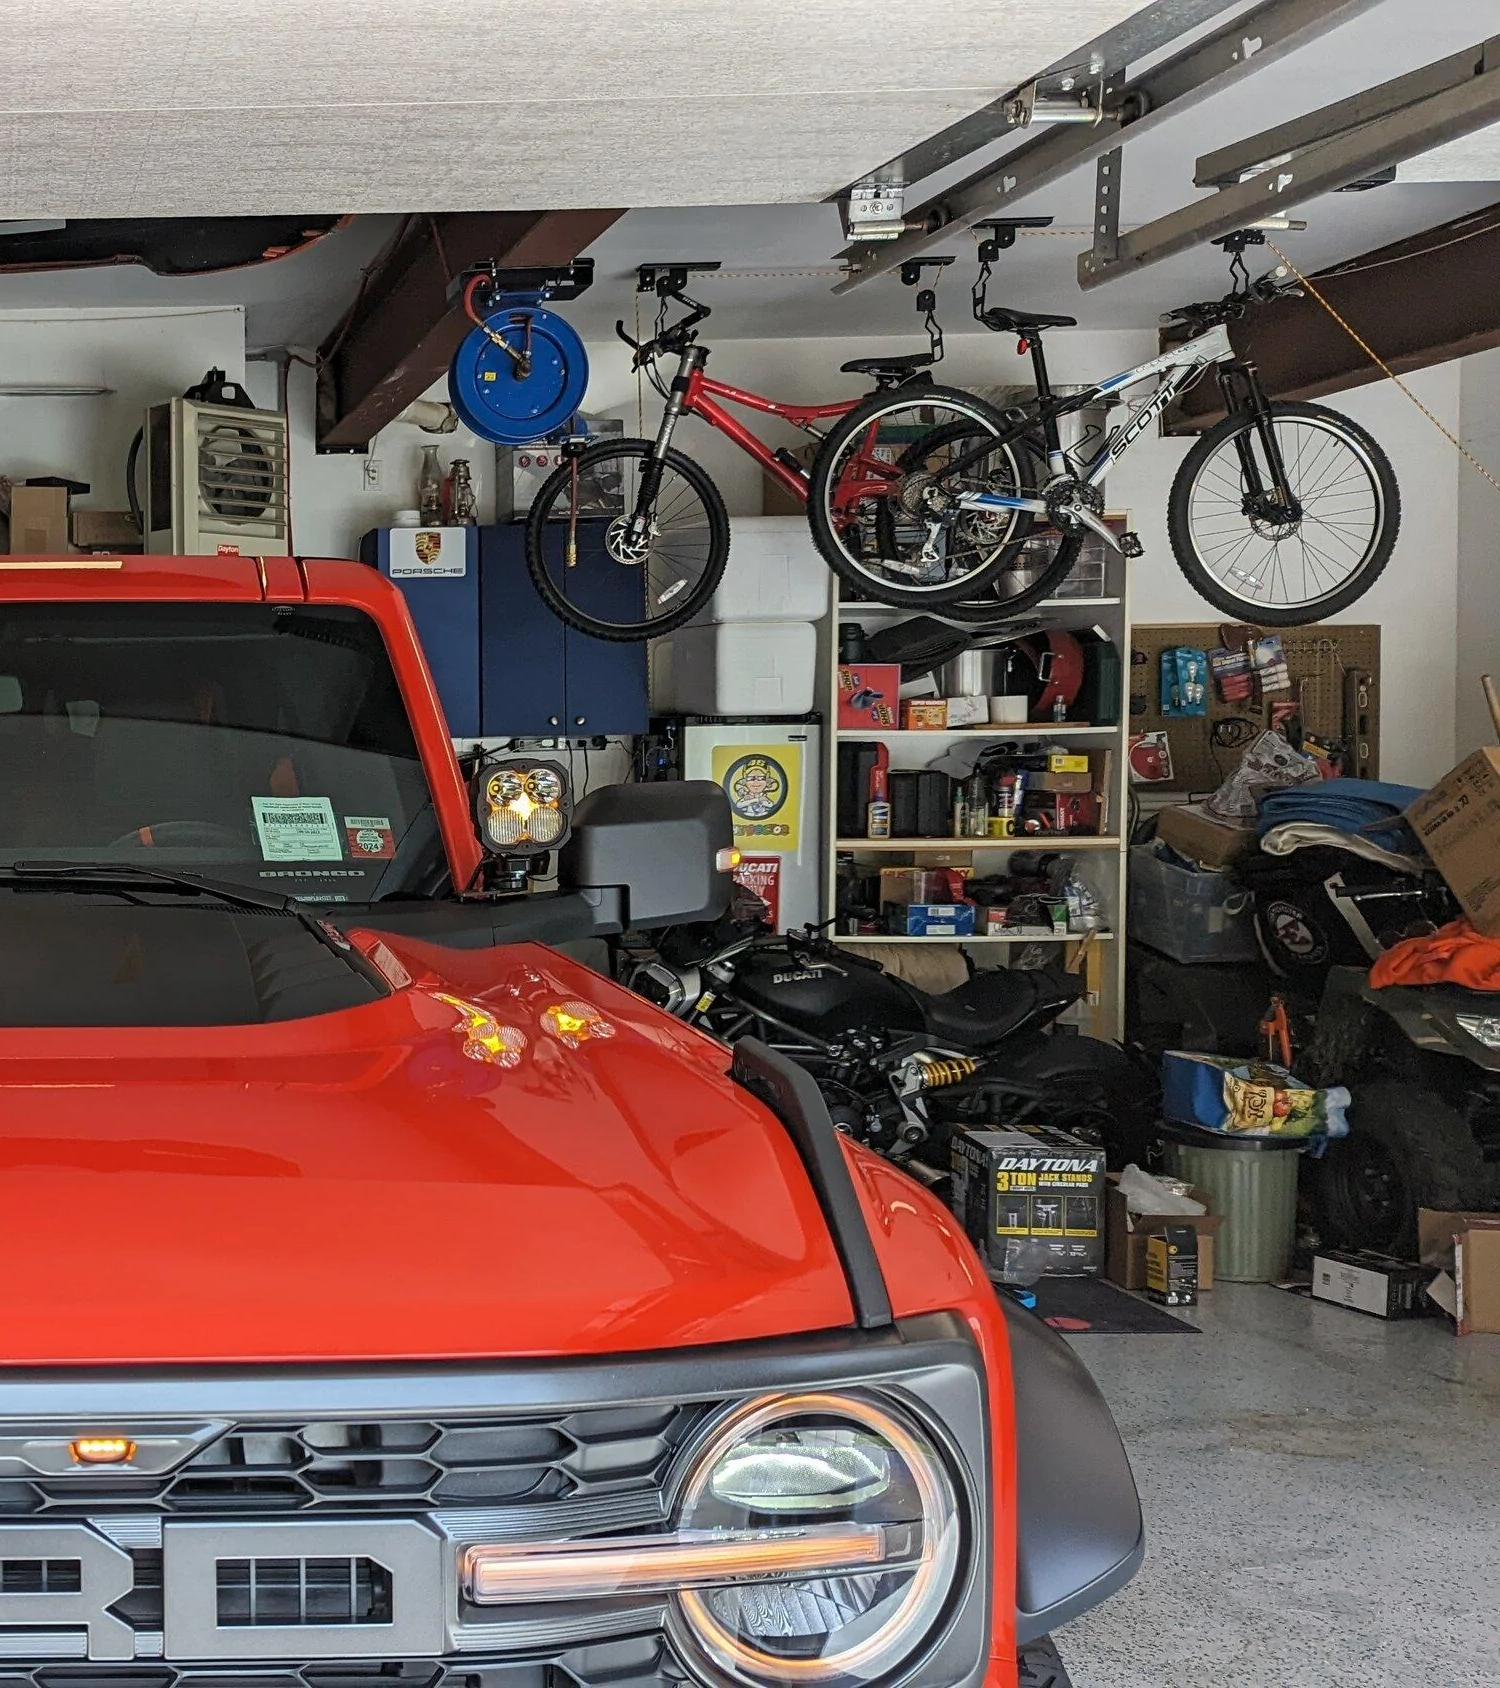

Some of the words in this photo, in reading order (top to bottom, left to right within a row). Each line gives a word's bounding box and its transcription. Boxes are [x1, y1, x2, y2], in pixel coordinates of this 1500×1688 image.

[1111, 380, 1175, 461] SCOTT
[218, 545, 239, 554] Dayton
[391, 567, 464, 576] PORSCHE
[358, 842, 379, 850] 2024
[259, 870, 365, 878] BRONCO
[773, 969, 822, 984] DUCATI
[998, 1157, 1098, 1172] DAYTONA
[996, 1171, 1010, 1192] 3
[1010, 1172, 1037, 1187] TON
[1038, 1173, 1060, 1182] JACK
[1061, 1173, 1093, 1183] STANDS
